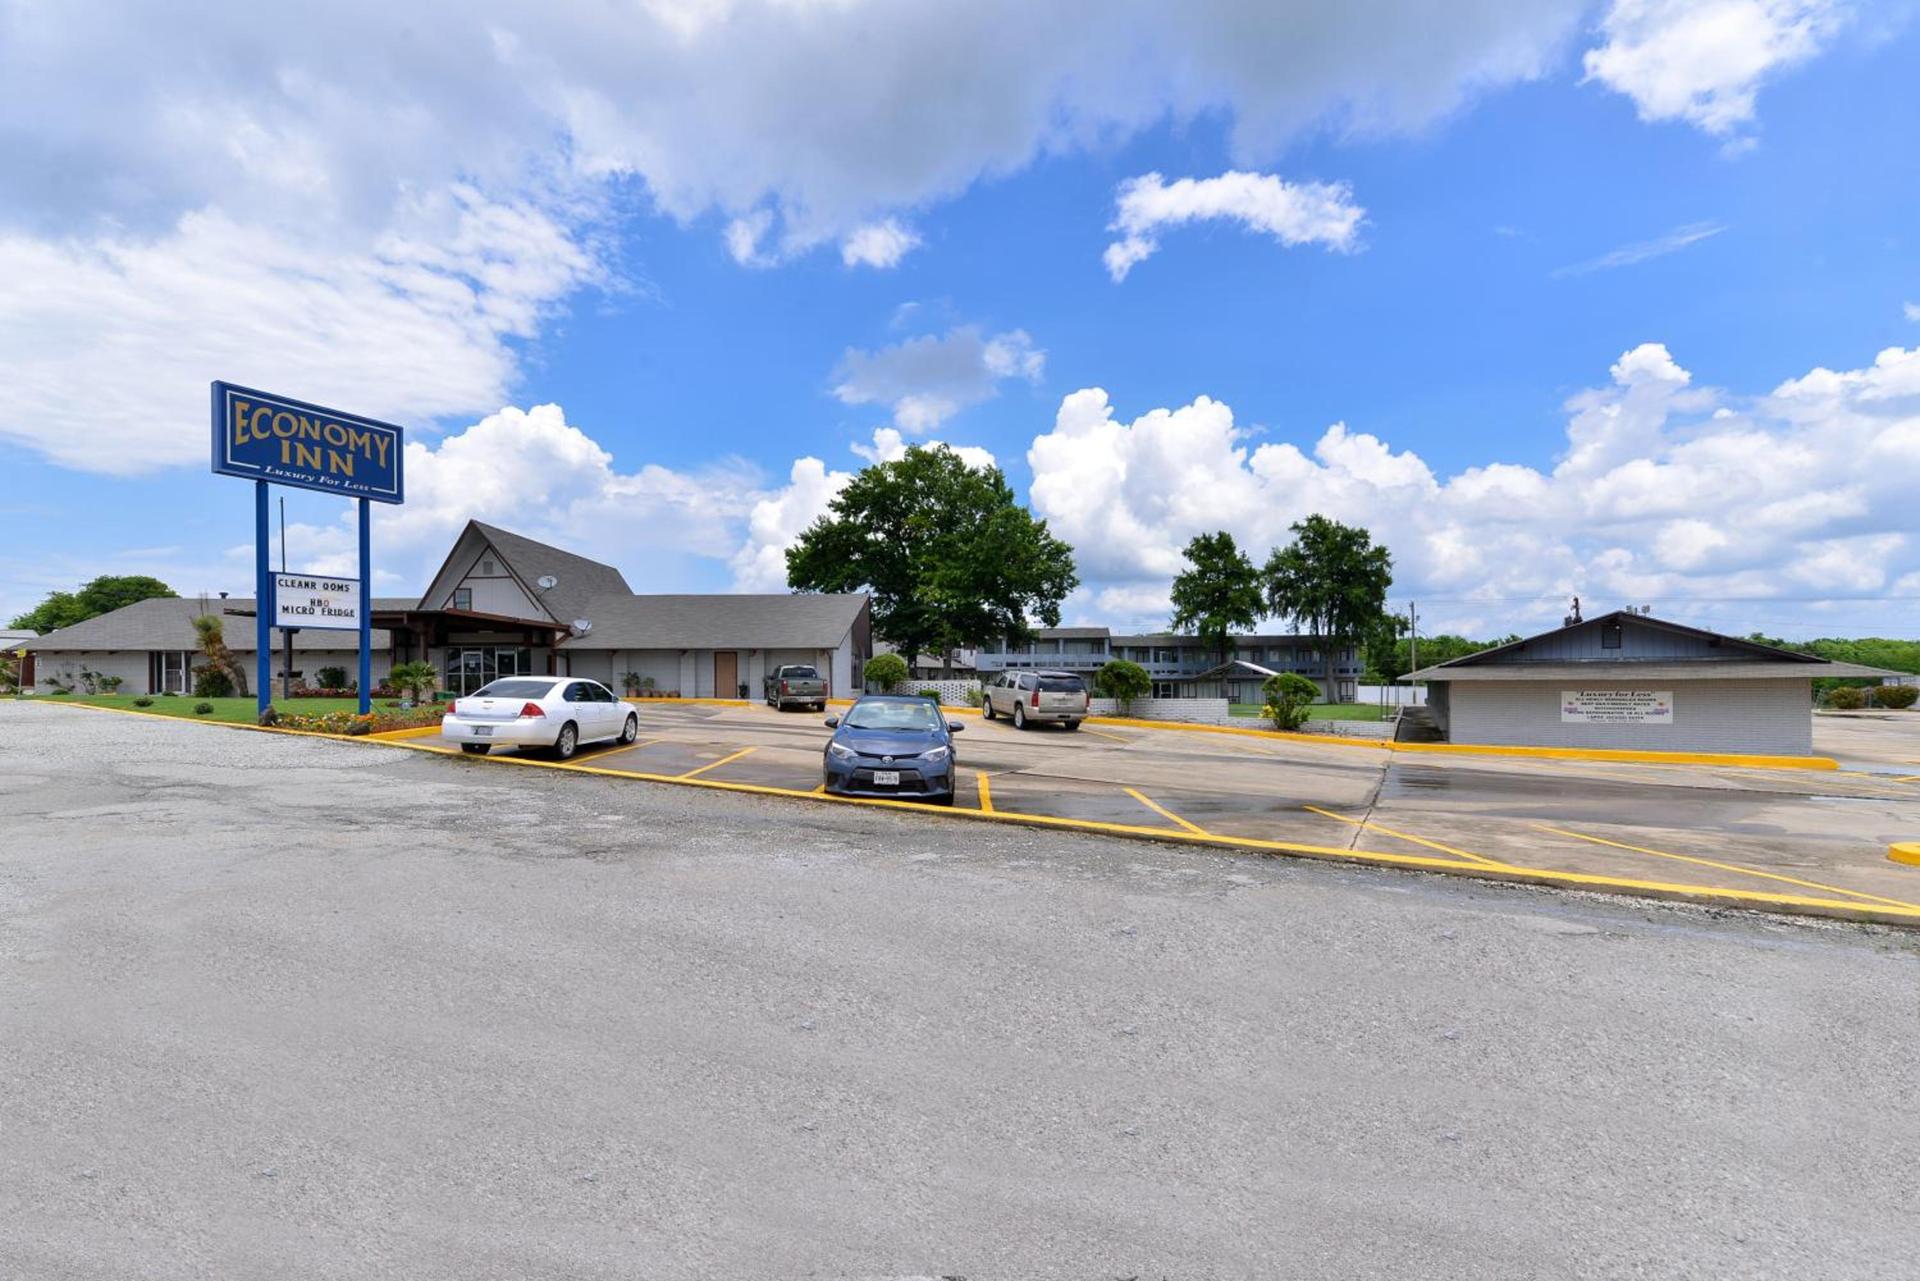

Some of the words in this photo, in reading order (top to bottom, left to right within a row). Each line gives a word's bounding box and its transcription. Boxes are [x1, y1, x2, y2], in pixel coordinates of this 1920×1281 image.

[235, 401, 390, 469] ECONOMY
[281, 439, 354, 477] INN
[264, 465, 315, 483] Luxury
[319, 476, 340, 486] For
[343, 480, 369, 491] Less
[282, 605, 315, 615] MICRO
[321, 608, 355, 617] FRIDGE
[310, 598, 330, 607] HBO
